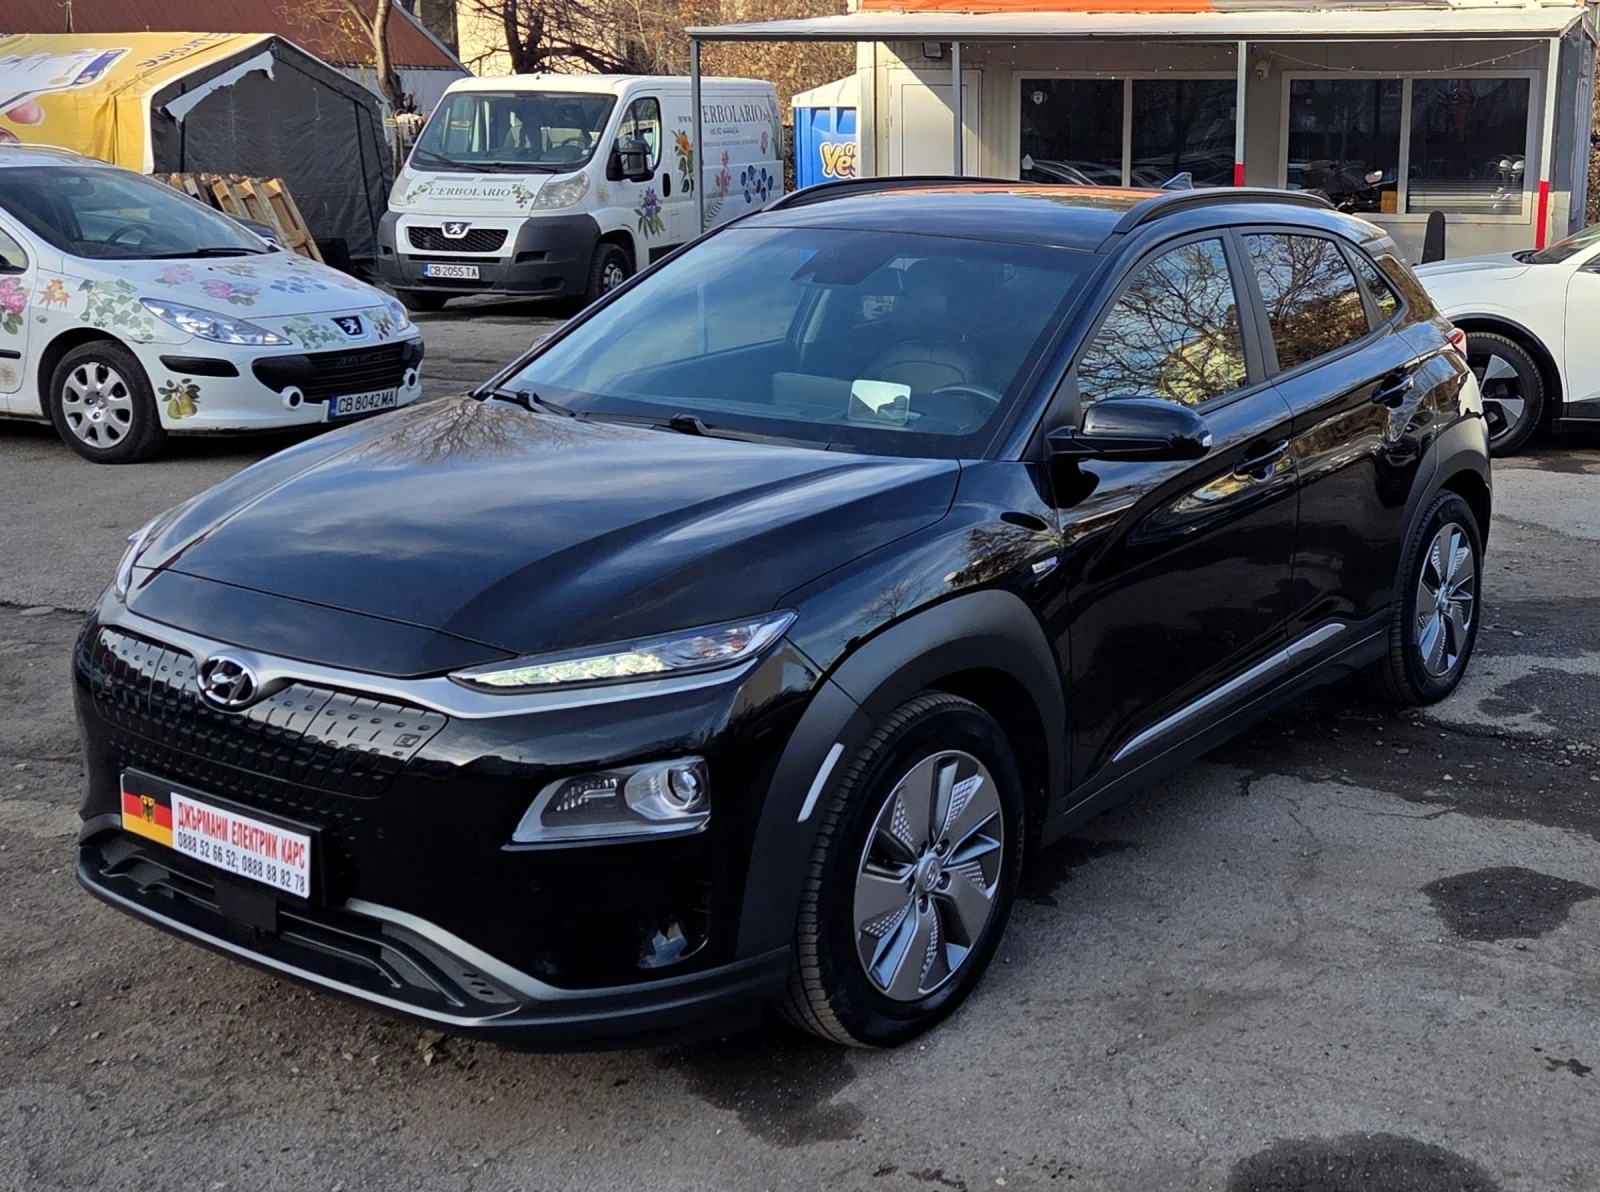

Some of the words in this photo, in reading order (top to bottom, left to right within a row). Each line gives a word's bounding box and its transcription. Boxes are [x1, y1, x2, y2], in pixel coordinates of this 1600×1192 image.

[702, 104, 762, 123] ERBOLARIO
[428, 187, 511, 197] L'ERBOLARIO
[430, 266, 441, 276] CB
[442, 266, 464, 277] 2055
[465, 267, 478, 278] TA
[338, 398, 353, 413] CB
[355, 392, 381, 411] 8042
[381, 390, 394, 405] MA
[178, 802, 228, 843] ДЖЪРМАНИ
[232, 821, 278, 860] ЕЛЕКТРИК
[282, 837, 305, 870] КАРС
[178, 831, 197, 853] 0888
[200, 840, 210, 858] 52
[213, 844, 223, 863] 66
[242, 855, 263, 878] 0888
[266, 863, 277, 883] 88
[280, 868, 291, 888] 82
[294, 873, 305, 893] 78
